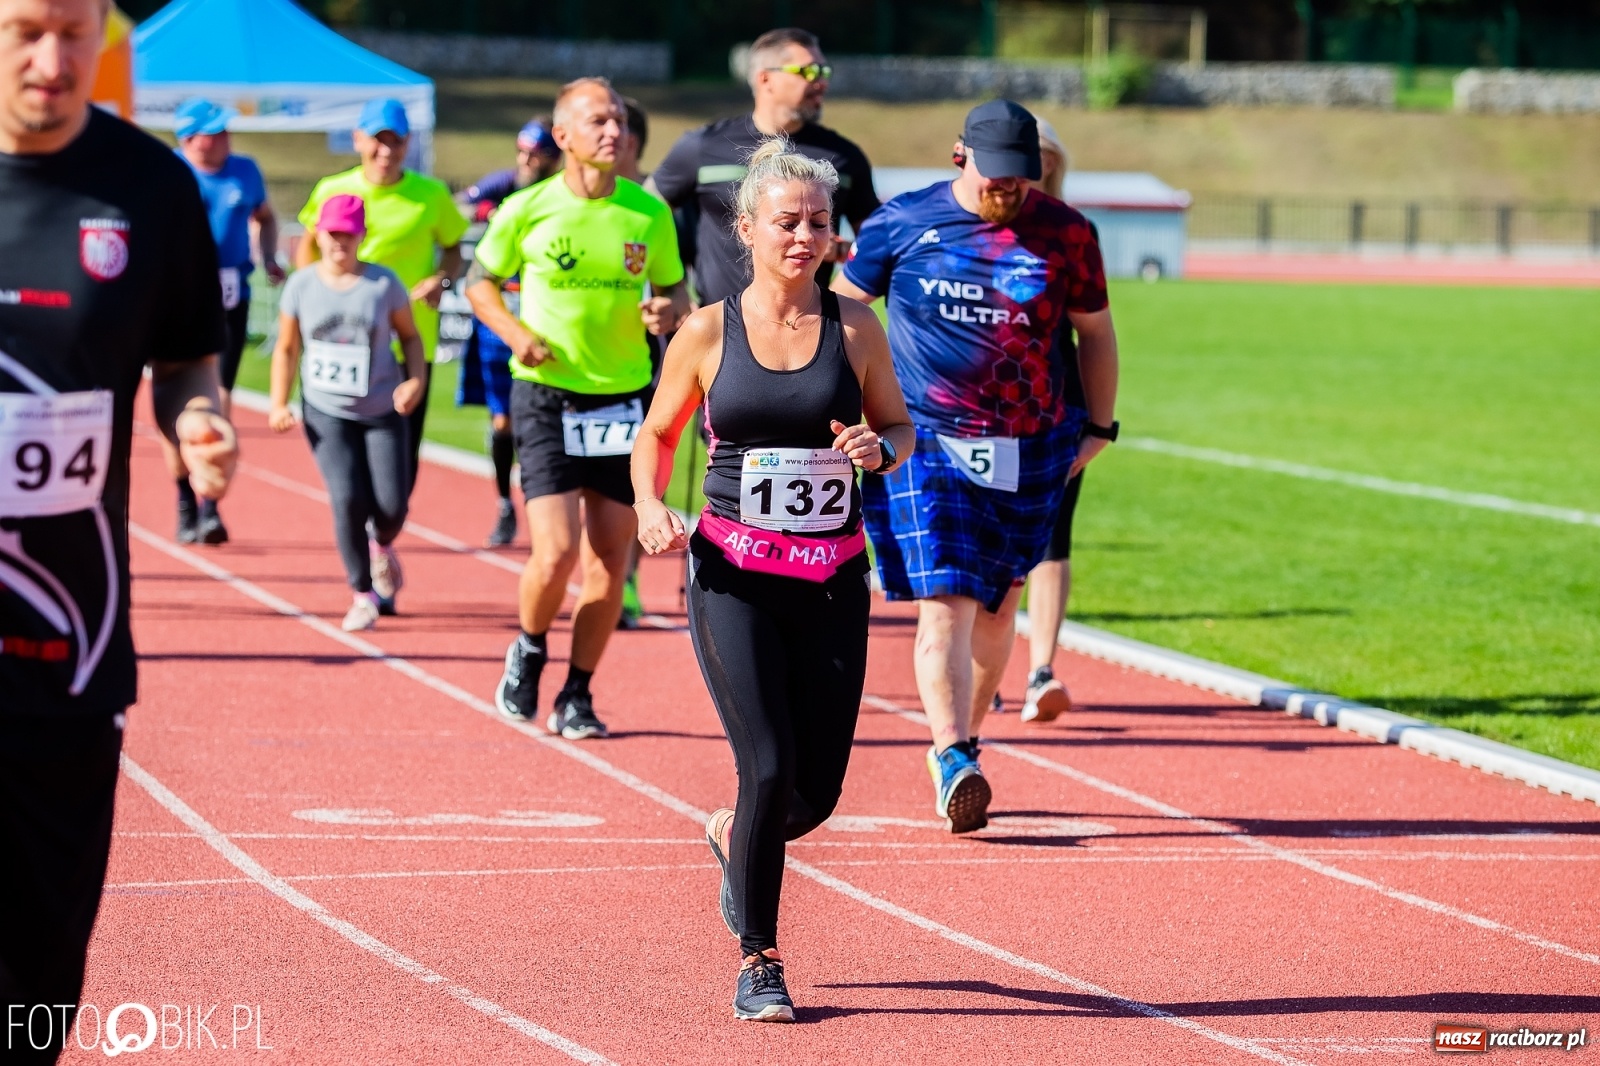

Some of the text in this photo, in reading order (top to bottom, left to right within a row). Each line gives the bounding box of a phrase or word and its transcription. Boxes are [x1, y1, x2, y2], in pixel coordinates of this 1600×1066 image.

[918, 278, 984, 301] YNO
[939, 302, 1031, 327] ULTRA
[313, 359, 358, 383] 221
[572, 421, 637, 444] 177
[15, 437, 97, 493] 94
[784, 456, 848, 467] www.personalbest.pl
[970, 448, 991, 475] 5
[750, 478, 846, 517] 132
[788, 543, 838, 565] MAX
